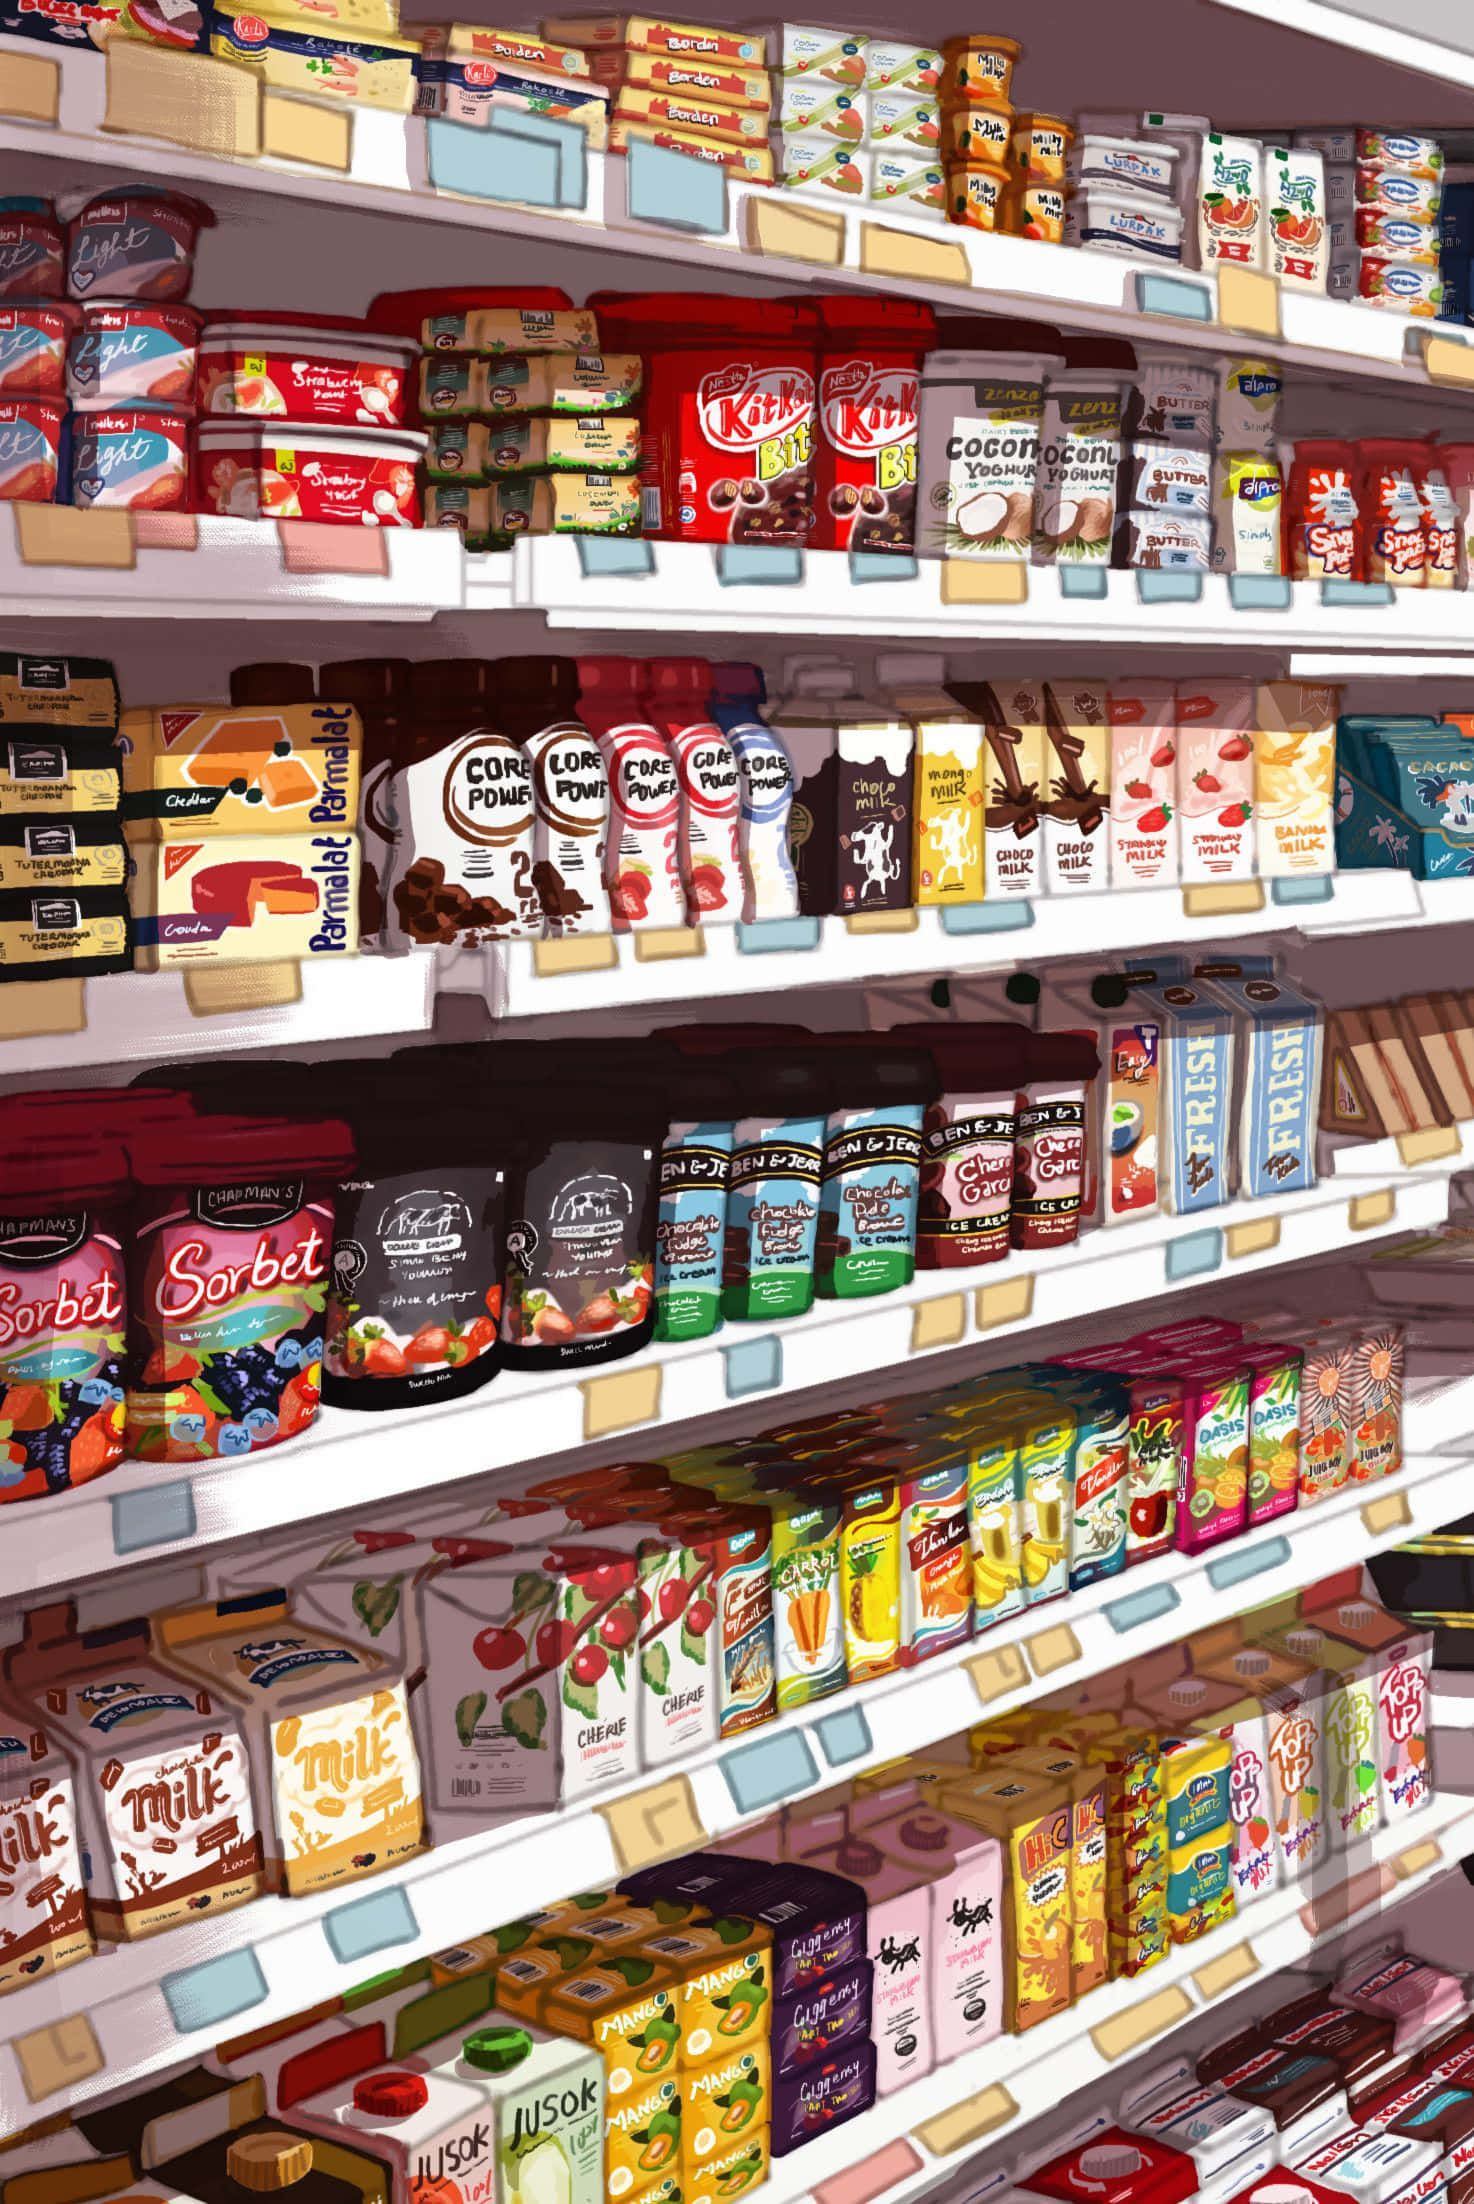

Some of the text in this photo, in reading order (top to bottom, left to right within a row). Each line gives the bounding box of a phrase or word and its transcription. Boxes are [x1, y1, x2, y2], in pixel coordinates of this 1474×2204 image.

[667, 37, 719, 54] Borden
[669, 70, 720, 88] Borden
[668, 105, 719, 127] Borden
[1104, 154, 1161, 177] LURPAK
[1110, 215, 1166, 237] LURPAK
[71, 227, 150, 271] Light
[76, 334, 149, 372] Light
[719, 374, 815, 440] KitKat
[1156, 396, 1211, 411] BUTTER
[78, 437, 153, 476] Light
[1047, 466, 1116, 484] YOGHURT
[1152, 469, 1209, 486] BUTTER
[1243, 480, 1280, 498] alpro
[1145, 535, 1202, 549] BUTTER
[309, 706, 353, 823] Parmalat
[466, 757, 533, 784] CORE
[549, 751, 602, 775] CORE
[623, 759, 673, 781] CORE
[693, 748, 733, 769] CORE
[740, 756, 787, 776] CORE
[748, 772, 791, 796] POWER
[928, 768, 972, 784] mango
[165, 793, 216, 808] Cheddar
[628, 779, 679, 801] POWER
[853, 778, 896, 802] choco
[855, 795, 897, 811] milk
[996, 849, 1034, 863] CHOCO
[1056, 842, 1094, 857] CHOCO
[1125, 848, 1166, 863] MILK
[1197, 843, 1241, 857] MILK
[1279, 837, 1326, 853] MILK
[998, 862, 1034, 877] MILK
[1058, 856, 1092, 872] MILK
[309, 835, 352, 952] Parmalat
[1116, 1049, 1152, 1080] Easy
[1185, 1022, 1217, 1159] FRESH
[1267, 1012, 1305, 1157] FRESH
[1018, 1109, 1051, 1127] BEN
[929, 1122, 972, 1148] BEN
[974, 1120, 992, 1135] &
[827, 1138, 863, 1163] BEN
[866, 1136, 884, 1153] &
[730, 1154, 765, 1179] BEN
[769, 1152, 784, 1170] &
[207, 1184, 293, 1208] CHAPMAN'S
[1034, 1202, 1057, 1213] ICE
[945, 1222, 970, 1233] ICE
[155, 1227, 325, 1317] Sorbet
[0, 1270, 122, 1340] Sorbet
[1251, 1402, 1298, 1427] OASIS
[1198, 1417, 1246, 1445] OASIS
[780, 1552, 837, 1587] CARROT
[293, 1726, 398, 1793] milk
[121, 1767, 232, 1834] milk
[0, 1812, 69, 1877] ilk
[684, 1951, 761, 2001] MANGO
[600, 1991, 669, 2041] MANGO
[689, 2054, 756, 2101] MANGO
[510, 2077, 599, 2152] JUSOK
[605, 2080, 676, 2139] MANGO
[413, 2122, 490, 2193] JUSOK
[694, 2138, 761, 2181] MANGO
